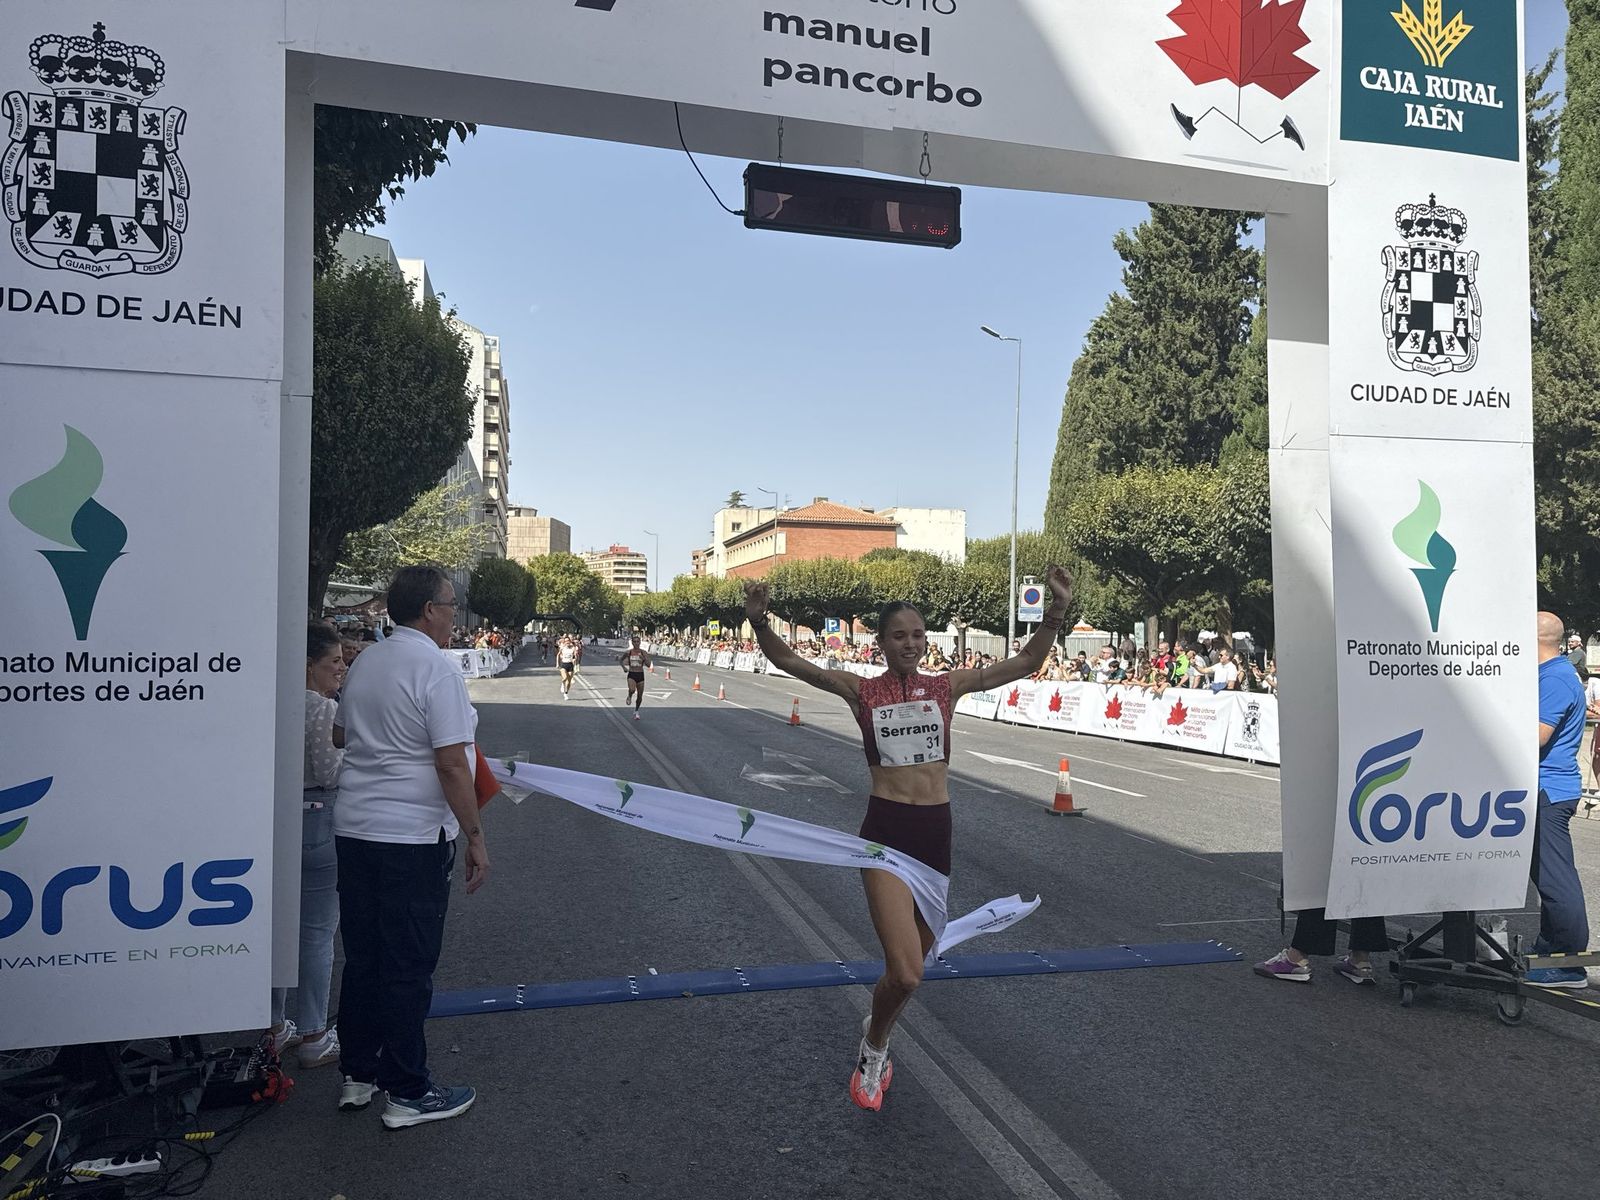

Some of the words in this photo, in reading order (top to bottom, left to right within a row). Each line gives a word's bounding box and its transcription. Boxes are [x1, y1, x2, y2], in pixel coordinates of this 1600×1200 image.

[764, 10, 930, 56] manuel
[764, 57, 983, 108] pancorbo
[1360, 66, 1420, 96] CAJA
[1425, 75, 1503, 109] RURAL
[12, 97, 21, 112] MUY
[14, 113, 23, 136] NOBLE
[1404, 104, 1464, 133] JAÉN
[166, 114, 177, 147] CASTILLA
[6, 191, 15, 216] CIUDAD
[176, 202, 185, 218] LOS
[14, 227, 22, 237] DE
[175, 219, 185, 229] DE
[65, 259, 104, 273] GUARDA
[104, 264, 111, 272] Y
[97, 294, 143, 321] DE
[152, 297, 242, 328] JAÉN
[1351, 384, 1427, 404] CIUDAD
[1433, 388, 1457, 406] DE
[1463, 386, 1510, 409] JAÉN
[1347, 639, 1422, 656] Patronato
[1427, 640, 1498, 659] Municipal
[1502, 641, 1520, 656] de
[65, 652, 199, 677] Municipal
[208, 652, 242, 674] de
[1369, 660, 1439, 680] Deportes
[1443, 661, 1462, 676] de
[1466, 660, 1501, 676] Jaén
[95, 680, 130, 702] de
[139, 679, 205, 702] Jaén
[880, 708, 894, 720] 37
[880, 723, 939, 738] Serrano
[926, 735, 940, 749] 31
[1351, 852, 1451, 865] POSITIVAMENTE
[1456, 851, 1473, 861] EN
[1478, 849, 1521, 861] FORMA
[128, 948, 158, 961] EN
[170, 943, 250, 960] FORMA
